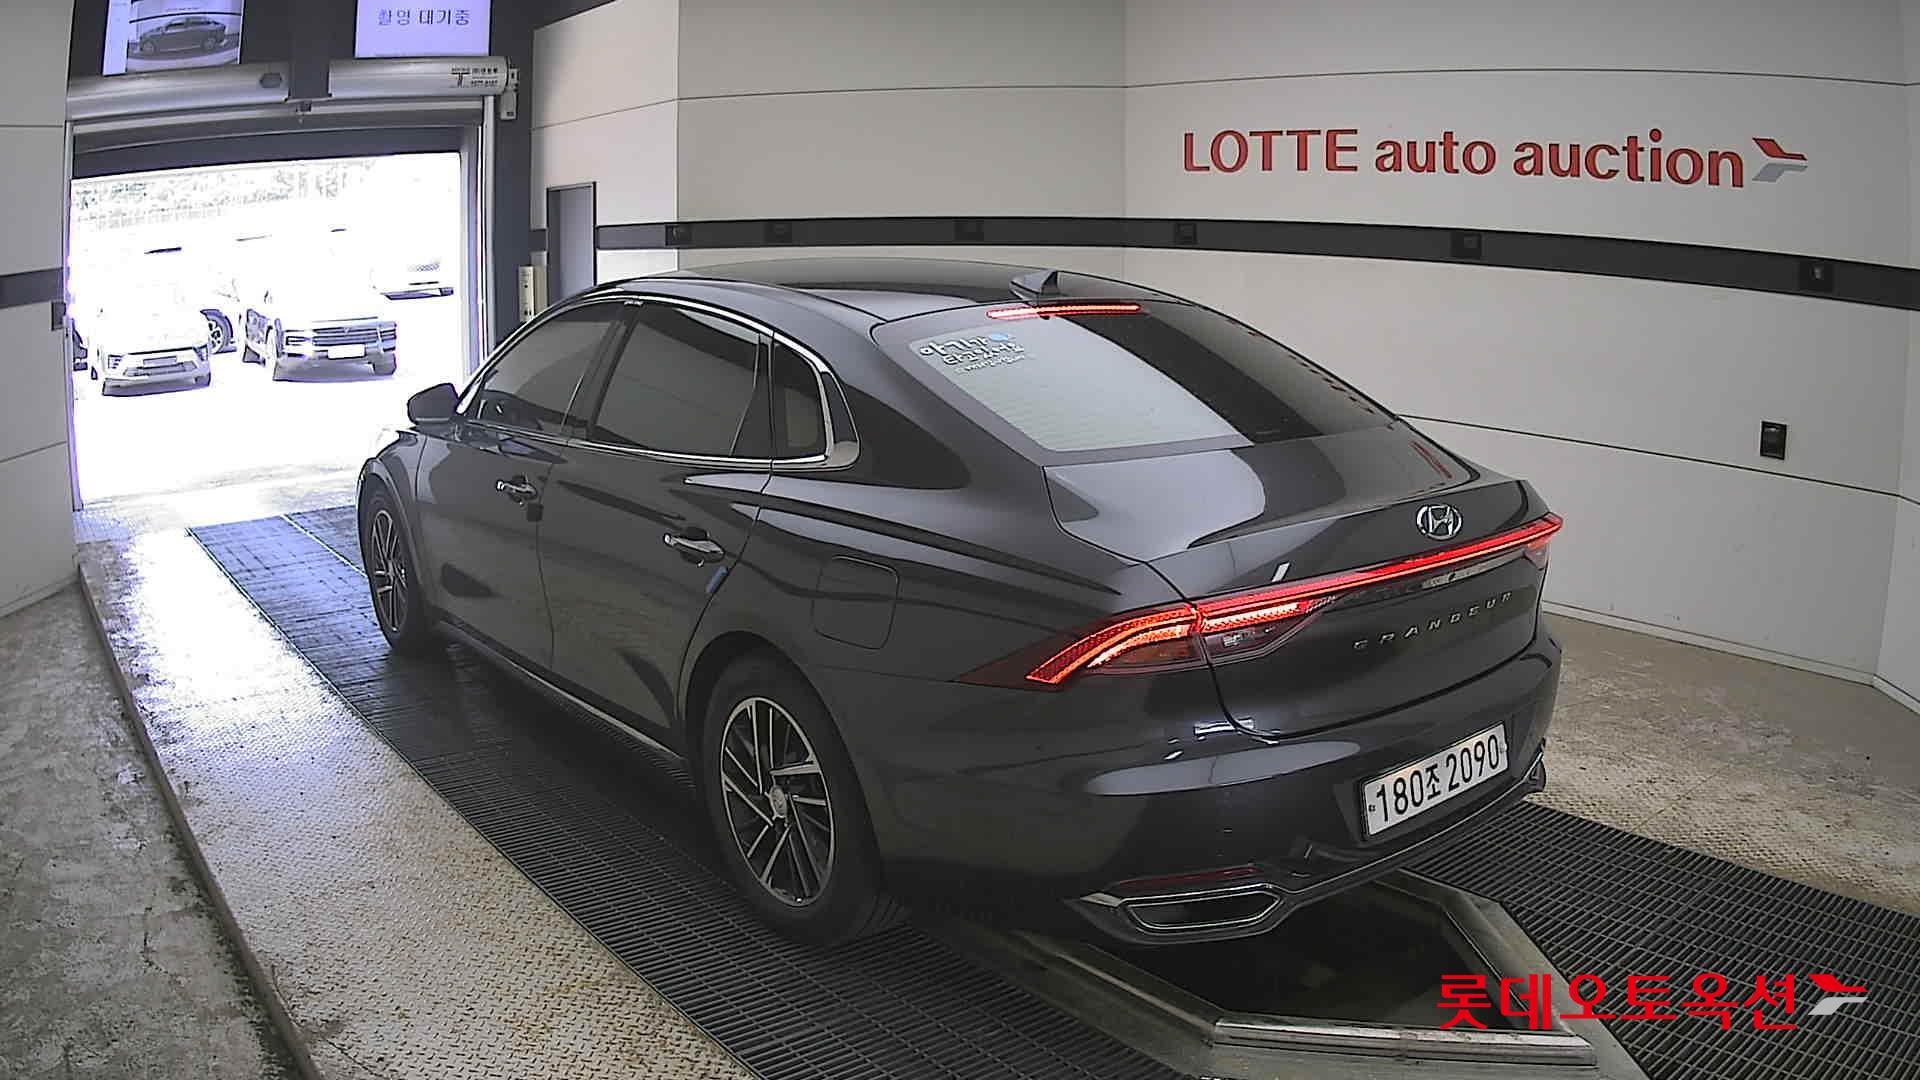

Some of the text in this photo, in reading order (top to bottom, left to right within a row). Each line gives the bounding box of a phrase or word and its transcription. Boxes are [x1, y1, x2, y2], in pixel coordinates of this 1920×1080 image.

[418, 9, 470, 26] 대기중
[1184, 128, 1744, 188] LOTTE auto auction
[1353, 591, 1513, 649] GRANDEUR
[1446, 734, 1500, 792] 2090
